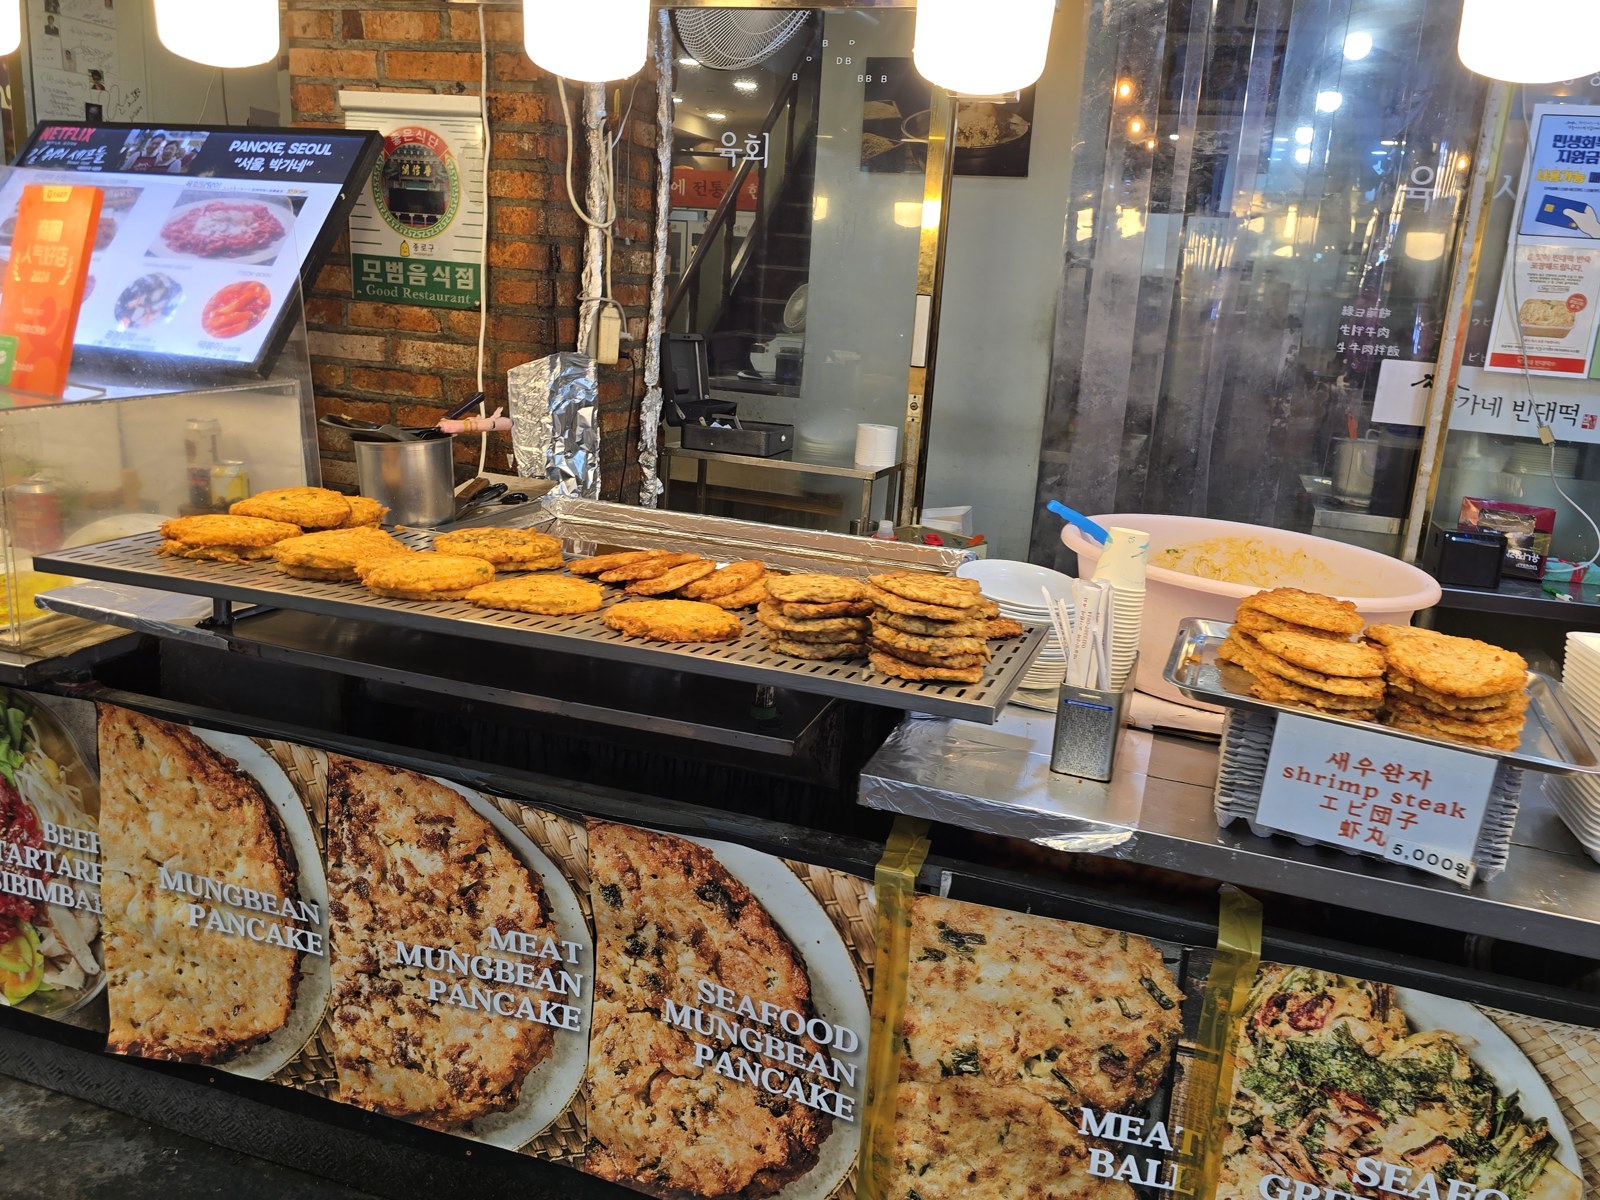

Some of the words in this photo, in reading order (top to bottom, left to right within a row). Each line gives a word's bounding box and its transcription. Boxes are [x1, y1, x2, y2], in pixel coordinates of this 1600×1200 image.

[38, 126, 97, 142] NETFLIX
[228, 140, 286, 156] PANCKE,
[288, 142, 332, 156] SEOUL
[714, 131, 769, 169] 육회
[1552, 134, 1600, 149] 민생회
[1555, 149, 1600, 165] 지원금
[413, 242, 434, 252] 종로구
[361, 258, 474, 290] 모범음식점
[365, 284, 398, 298] Good
[402, 288, 472, 305] Restaurant
[1454, 393, 1503, 418] 가네
[1513, 399, 1580, 427] 빈대떡
[1325, 751, 1433, 790] 새우완자
[1282, 765, 1380, 801] shrimp
[1390, 791, 1467, 819] steak
[1392, 843, 1471, 880] 5,000원
[158, 866, 320, 926] MUNGBEAN
[187, 903, 324, 957] PANCAKE
[489, 926, 583, 965] MEAT
[394, 940, 584, 998] MUNGBEAN
[426, 977, 582, 1032] PANCAKE
[697, 979, 860, 1054] SEAFOOD
[663, 997, 859, 1088] MUNGBEAN
[693, 1041, 856, 1122] PANCAKE
[1079, 1106, 1203, 1157] MEAT
[1085, 1147, 1195, 1197] BALL
